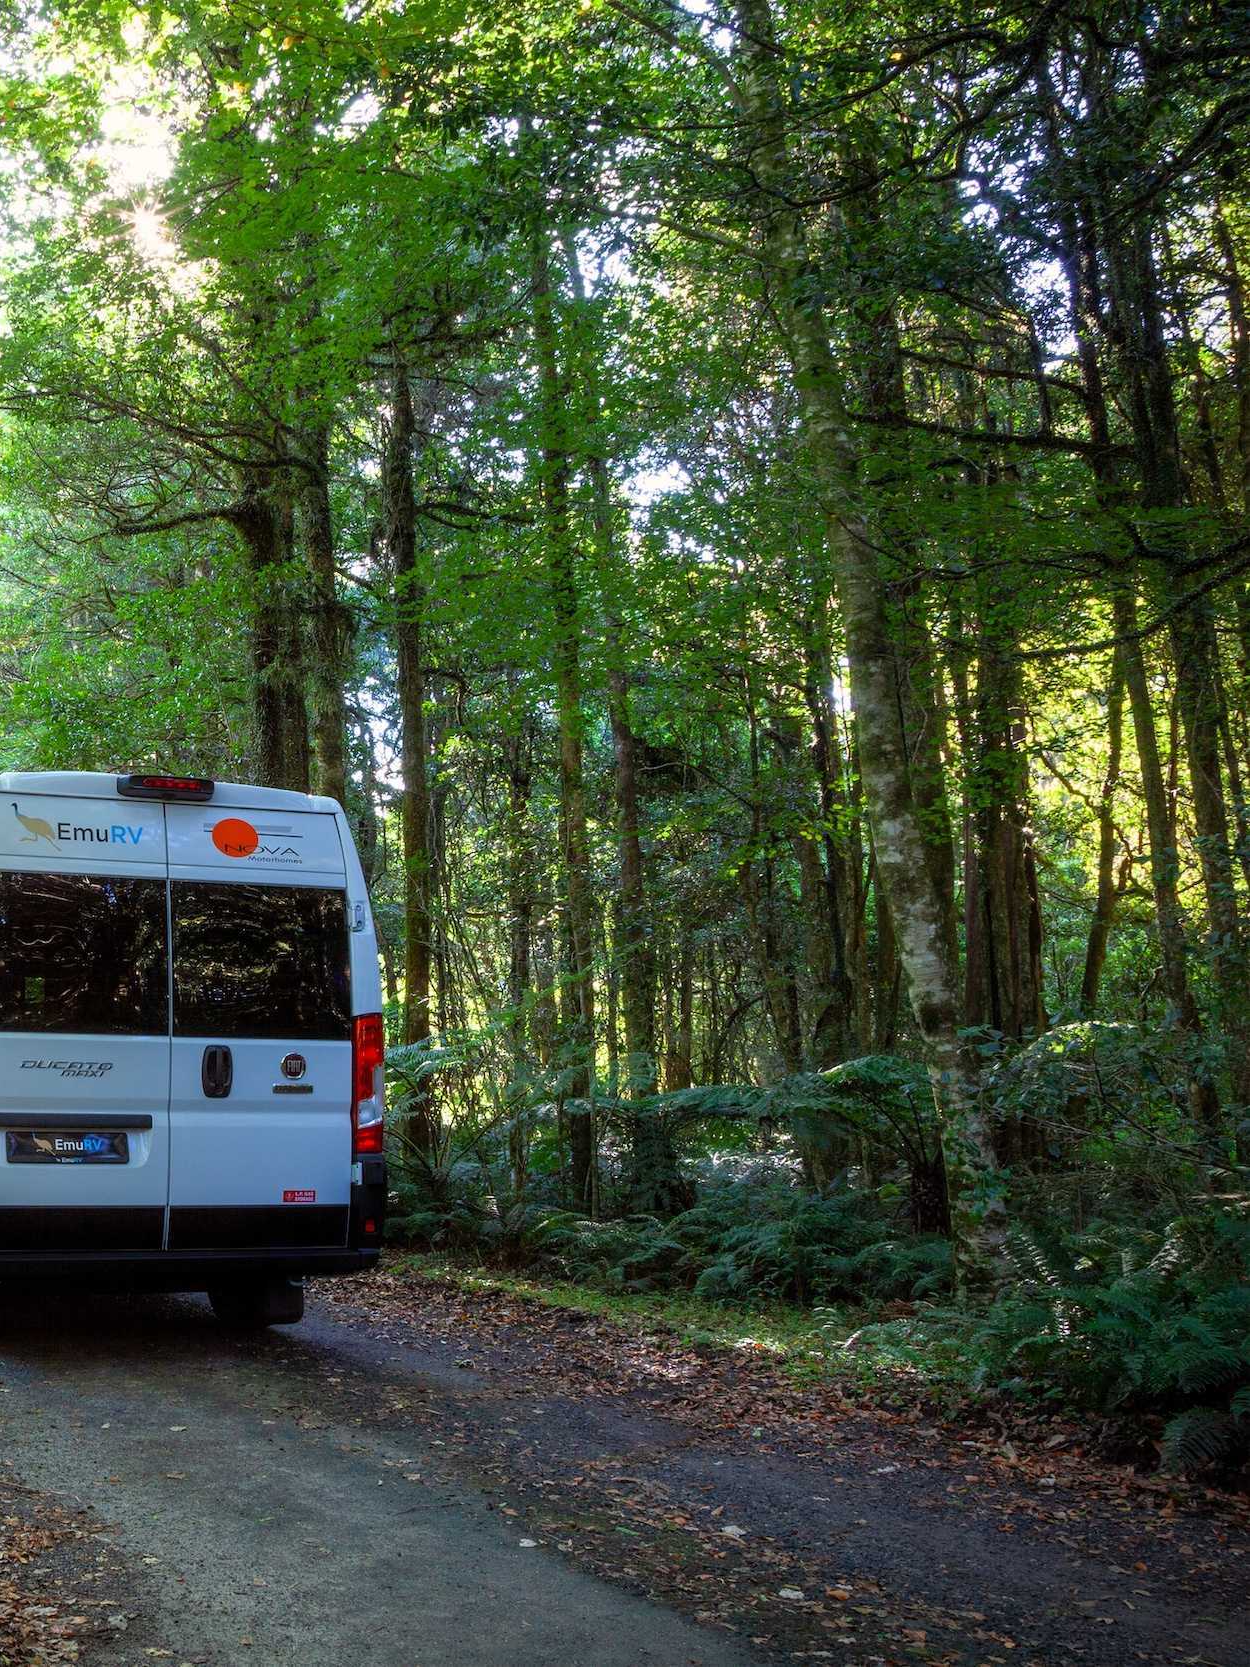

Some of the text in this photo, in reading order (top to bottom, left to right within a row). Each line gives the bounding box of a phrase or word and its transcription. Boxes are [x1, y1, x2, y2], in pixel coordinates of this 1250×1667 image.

[57, 822, 143, 845] EmuRV
[224, 843, 300, 856] NOVA
[247, 856, 303, 864] Motorhomes
[20, 1060, 114, 1071] DUCATO
[287, 1060, 302, 1073] FIAT
[54, 1138, 102, 1151] EmuRV
